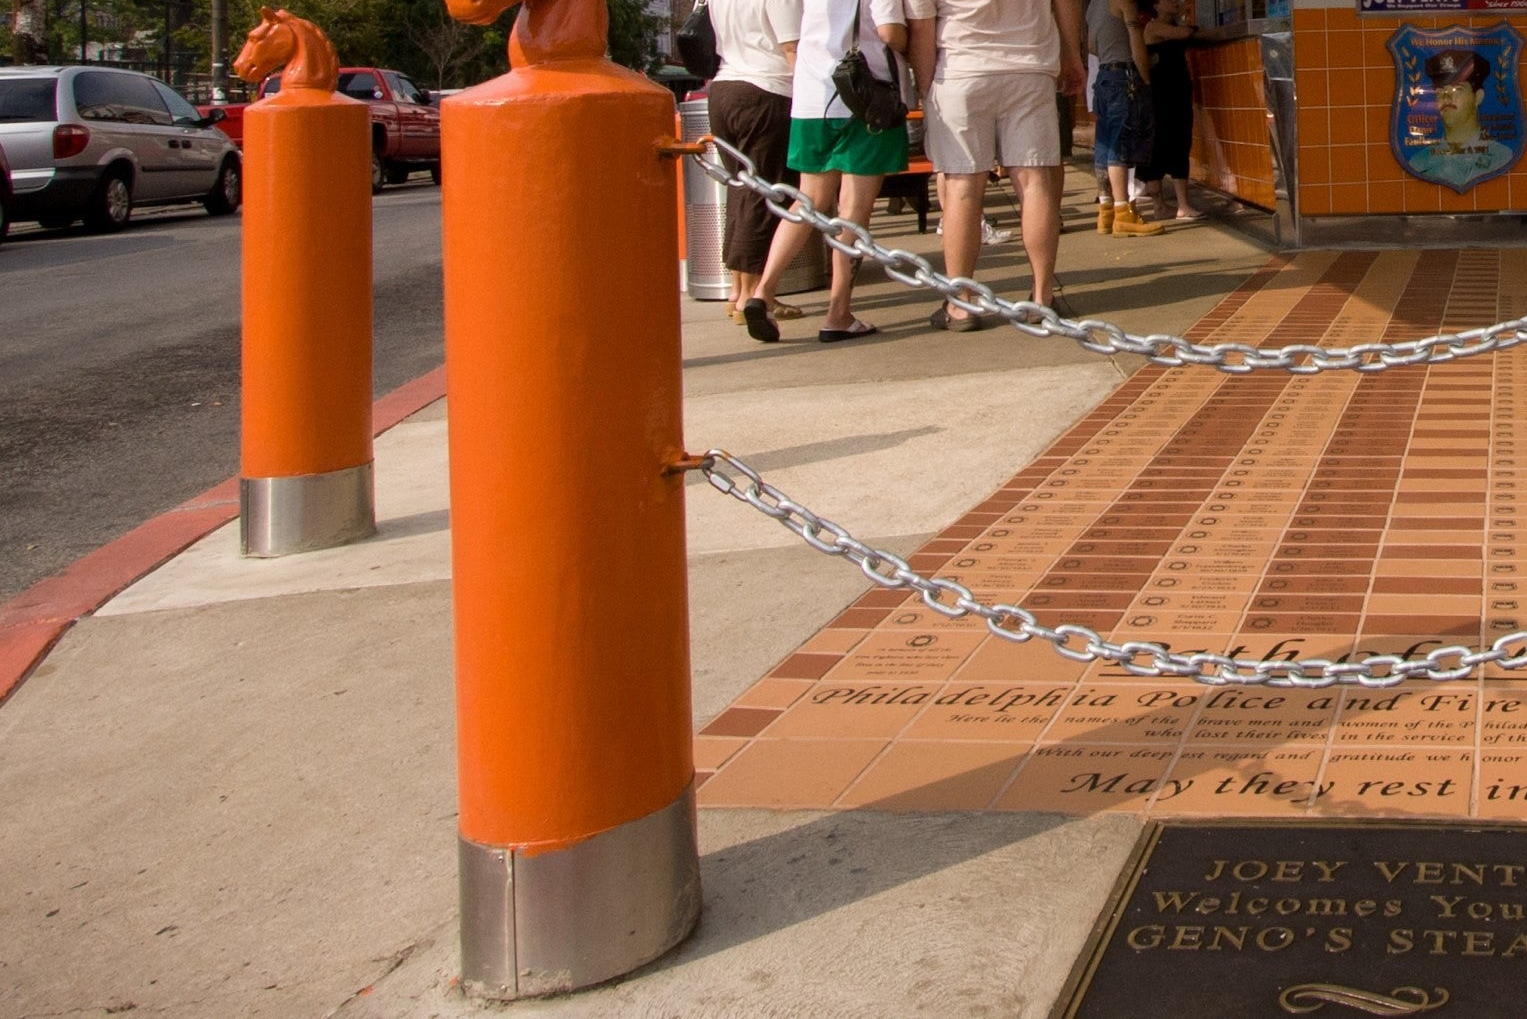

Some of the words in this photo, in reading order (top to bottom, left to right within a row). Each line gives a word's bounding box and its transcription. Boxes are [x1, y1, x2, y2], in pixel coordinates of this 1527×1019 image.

[812, 686, 1118, 712] Philadelphia
[1137, 689, 1286, 710] Police
[1307, 692, 1412, 712] and
[1421, 694, 1521, 713] Fire
[946, 714, 986, 724] Here
[994, 714, 1015, 724] lie
[1020, 714, 1048, 724] the
[1065, 717, 1119, 725] names
[1125, 716, 1147, 726] of
[1152, 716, 1179, 726] the
[1197, 717, 1243, 727] brave
[1248, 719, 1282, 727] men
[1289, 718, 1325, 728] and
[1340, 721, 1398, 729] women
[1405, 720, 1420, 731] of
[1428, 720, 1456, 730] the
[1144, 728, 1182, 738] who
[1195, 729, 1229, 739] lost
[1235, 729, 1278, 740] their
[1286, 730, 1327, 741] lives
[1340, 732, 1358, 741] in
[1366, 731, 1394, 741] the
[1401, 733, 1466, 742] service
[1483, 732, 1503, 744] of
[1035, 746, 1085, 757] With
[1089, 750, 1119, 758] our
[1129, 749, 1205, 761] deepest
[1213, 750, 1269, 762] regard
[1275, 750, 1315, 761] and
[1329, 752, 1415, 764] gratitude
[1426, 754, 1451, 762] we
[1459, 752, 1523, 763] honor
[1060, 771, 1194, 801] May
[1214, 772, 1335, 803] they
[1357, 779, 1455, 797] rest
[1204, 859, 1353, 884] JOEY
[1151, 890, 1402, 918] Welcomes
[1430, 895, 1526, 923] You
[1126, 925, 1354, 954] GENO'S
